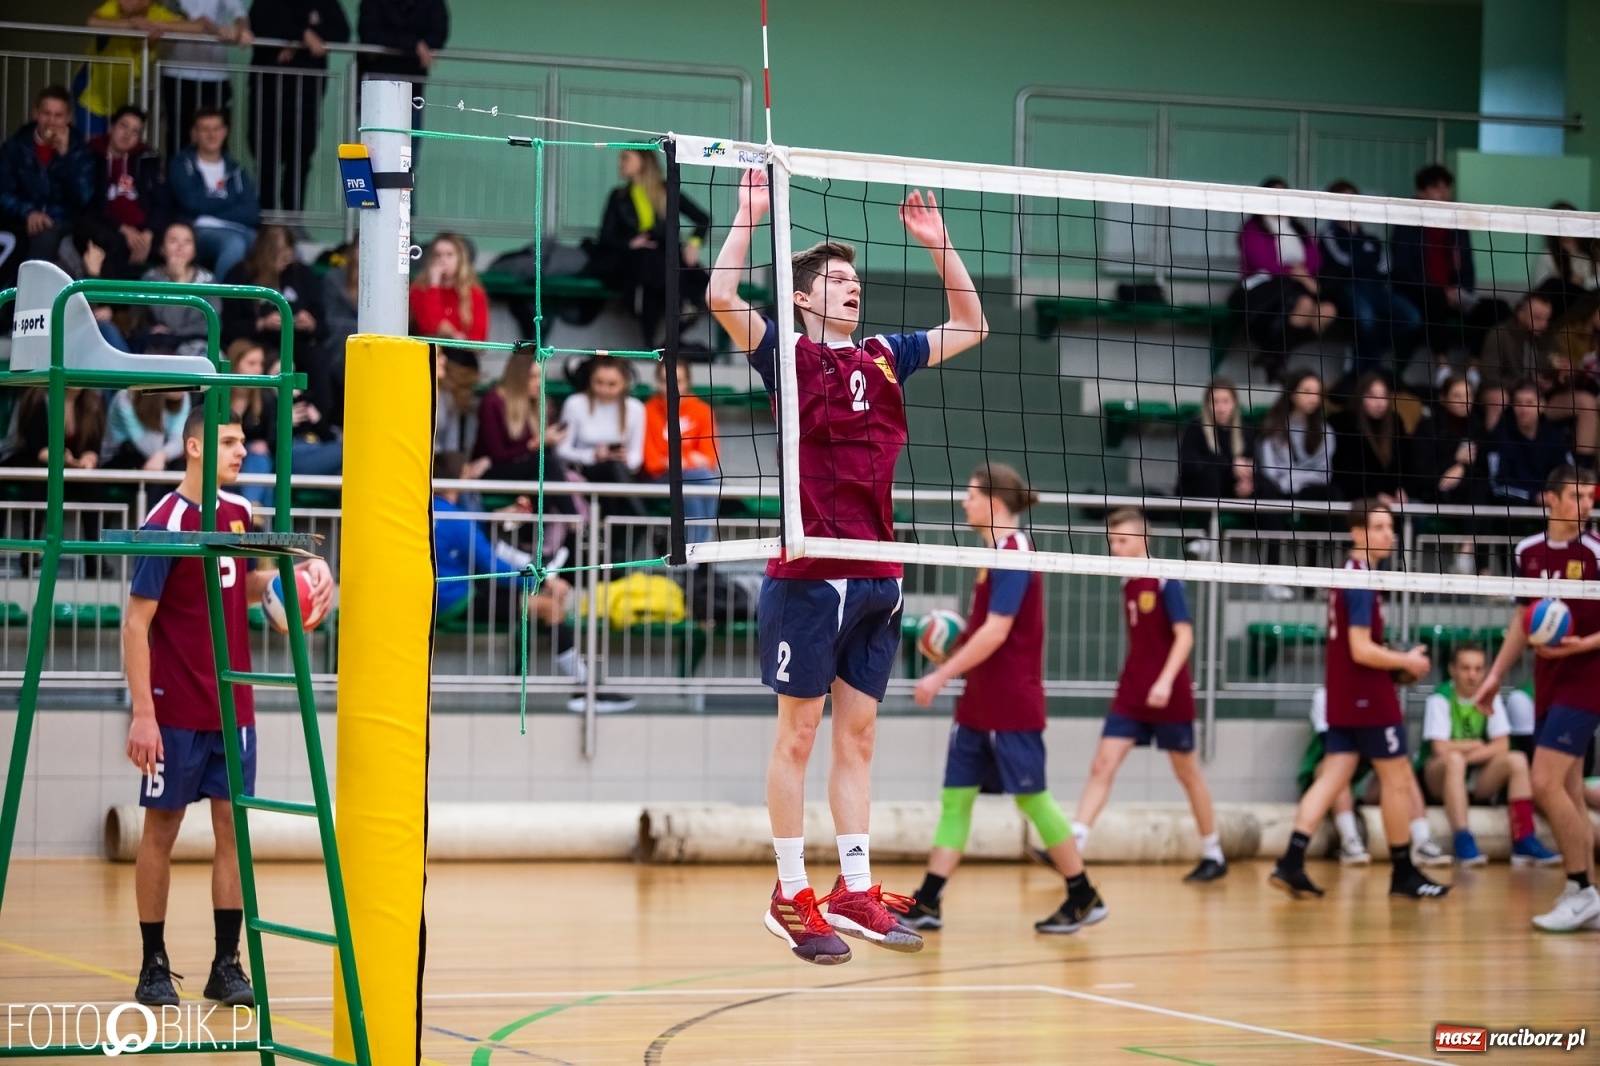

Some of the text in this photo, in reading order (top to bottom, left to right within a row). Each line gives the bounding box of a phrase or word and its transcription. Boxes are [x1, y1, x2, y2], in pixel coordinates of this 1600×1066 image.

[346, 178, 366, 189] FIVB
[849, 370, 870, 412] 2
[776, 641, 791, 683] 2
[146, 762, 165, 798] 15
